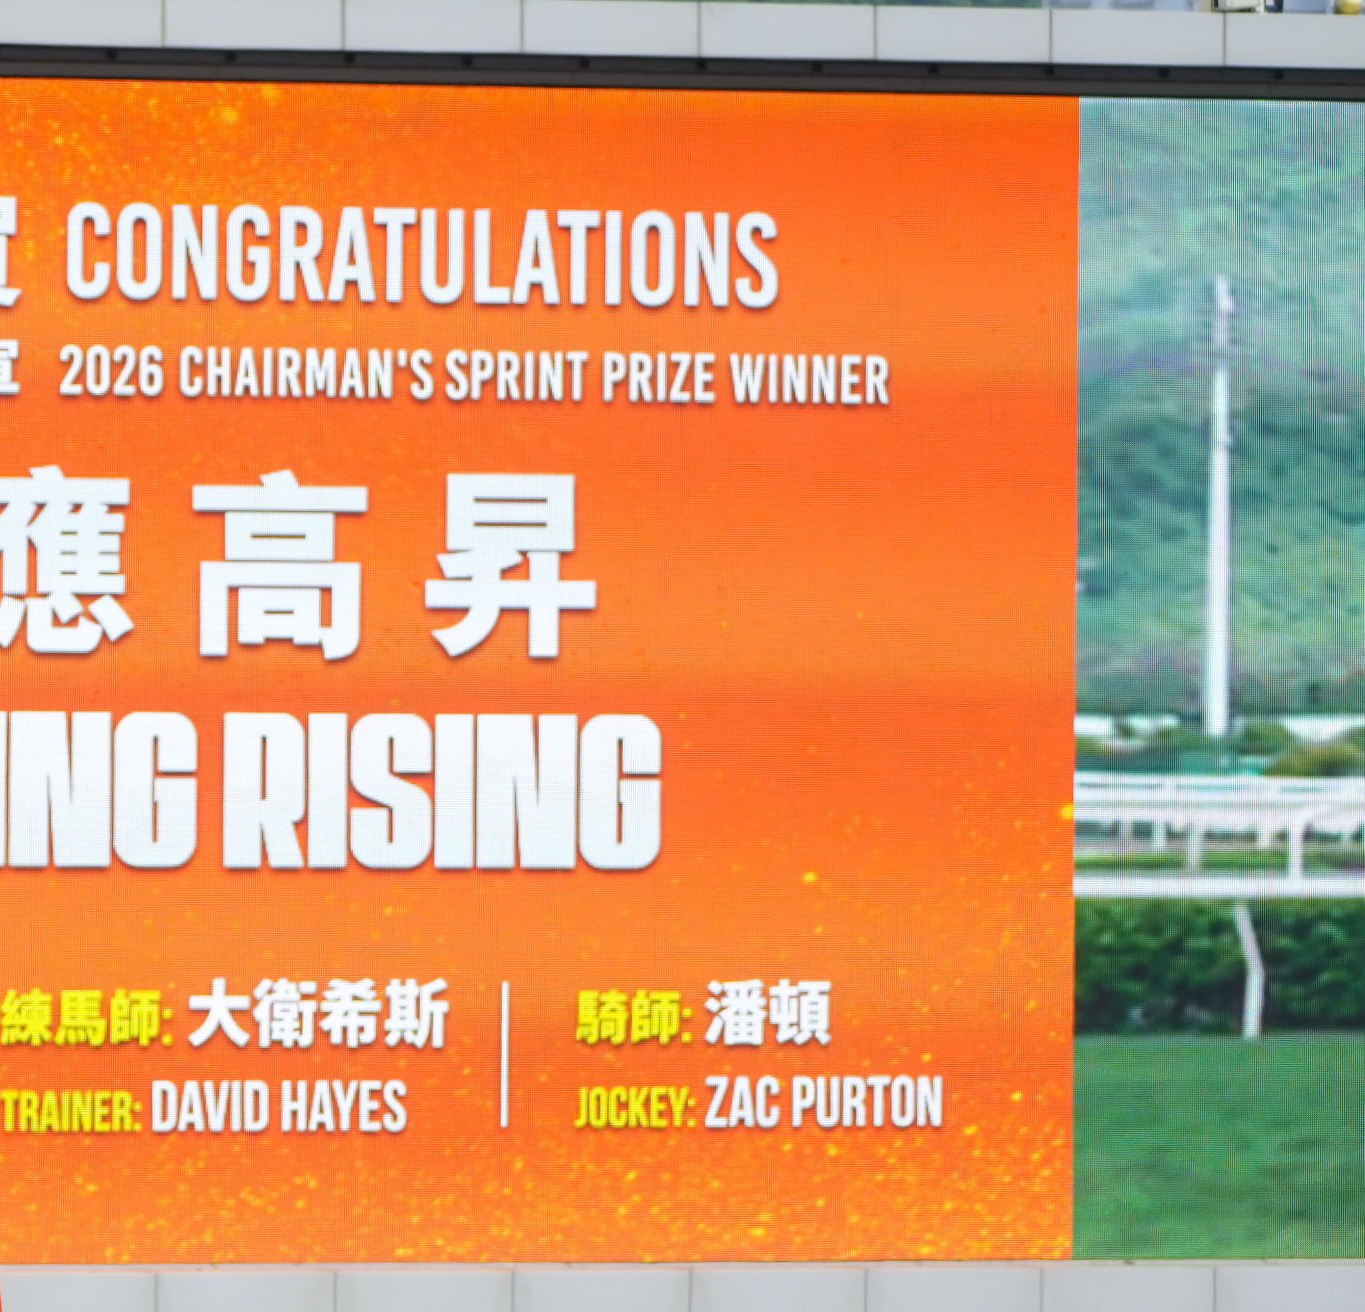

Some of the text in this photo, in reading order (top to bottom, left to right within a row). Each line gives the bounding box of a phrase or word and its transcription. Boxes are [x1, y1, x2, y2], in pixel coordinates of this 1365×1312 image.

[66, 202, 779, 309] CONGRATULATIONS
[59, 345, 889, 405] 2026 CHAIRMAN'S SPRINT PRIZE WINNER
[222, 710, 662, 869] RISING
[188, 977, 450, 1048] 大衛希斯
[704, 978, 832, 1045] 潘頓
[0, 1079, 407, 1133] TRAINER: DAVID HAYES
[575, 1075, 943, 1128] JOCKEY: ZAC PURTON
